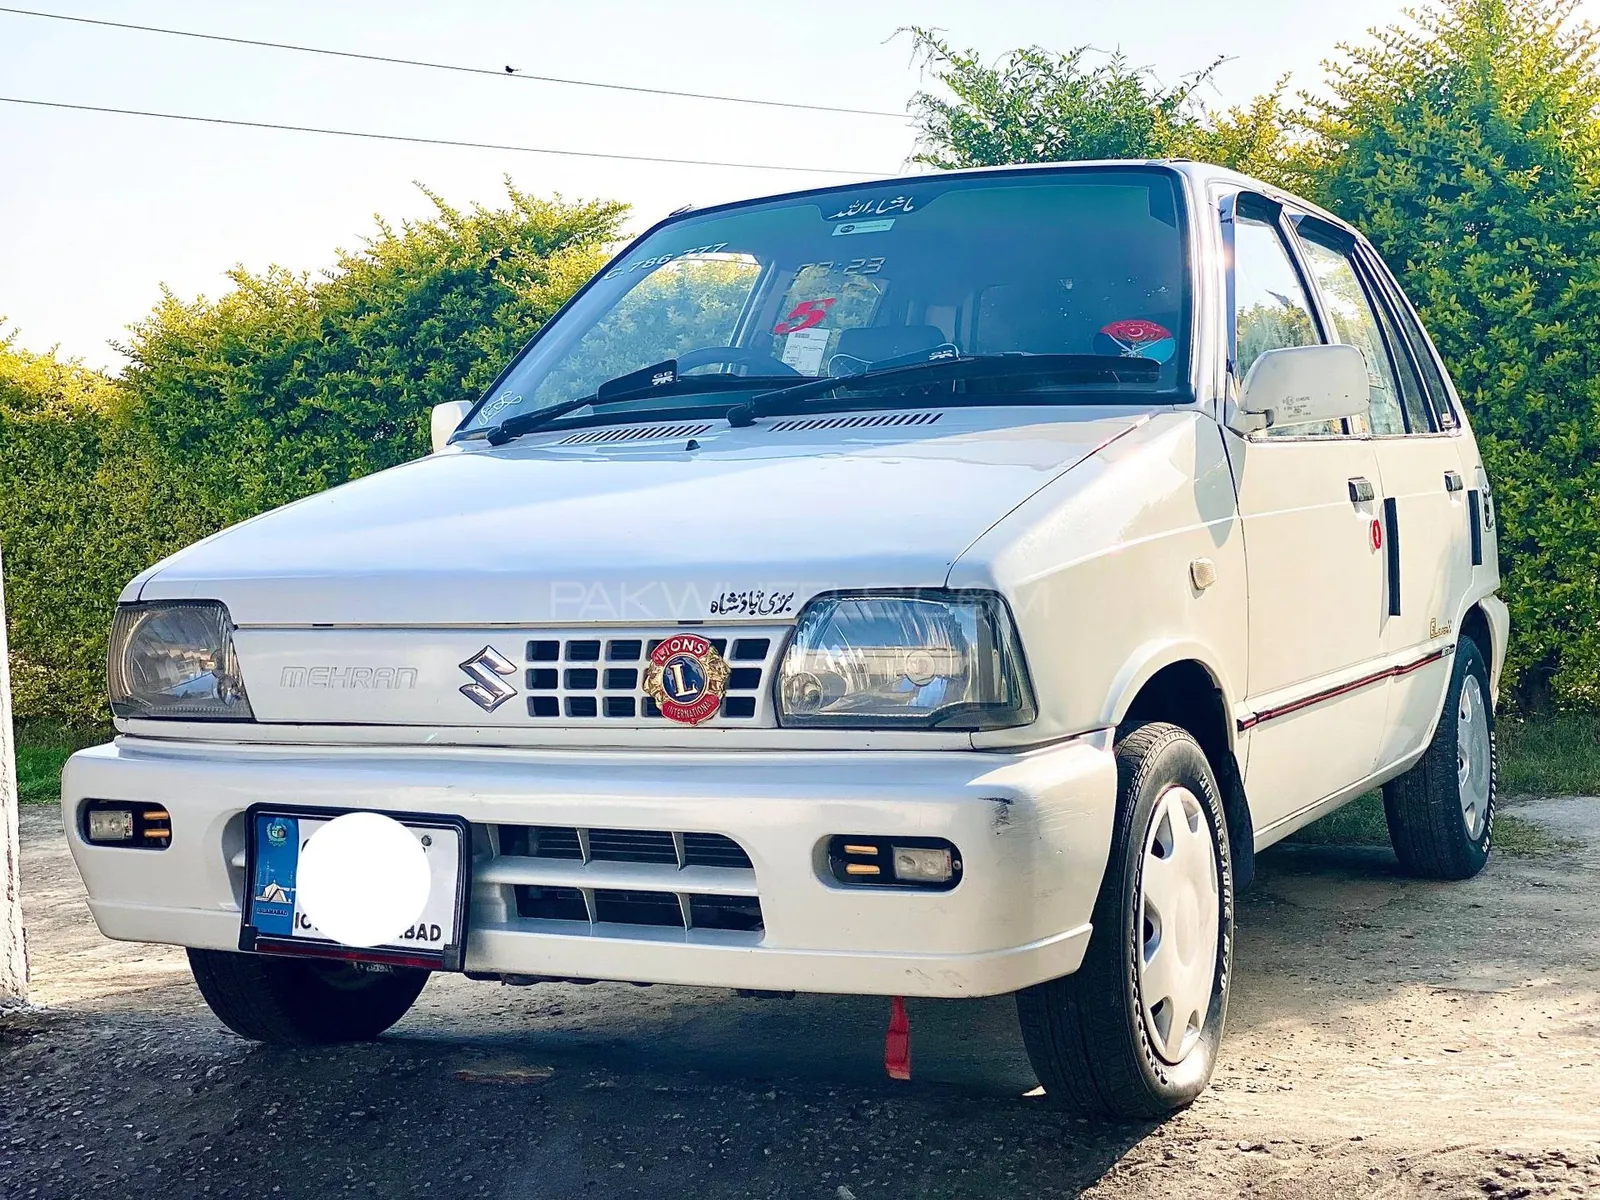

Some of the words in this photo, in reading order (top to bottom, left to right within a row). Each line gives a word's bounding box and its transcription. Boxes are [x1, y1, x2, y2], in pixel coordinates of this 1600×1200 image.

[628, 253, 674, 271] 786
[656, 638, 705, 661] LIONS
[279, 665, 418, 690] MEHRAN
[670, 663, 698, 697] L
[1199, 771, 1233, 921] BRIDGESTONE
